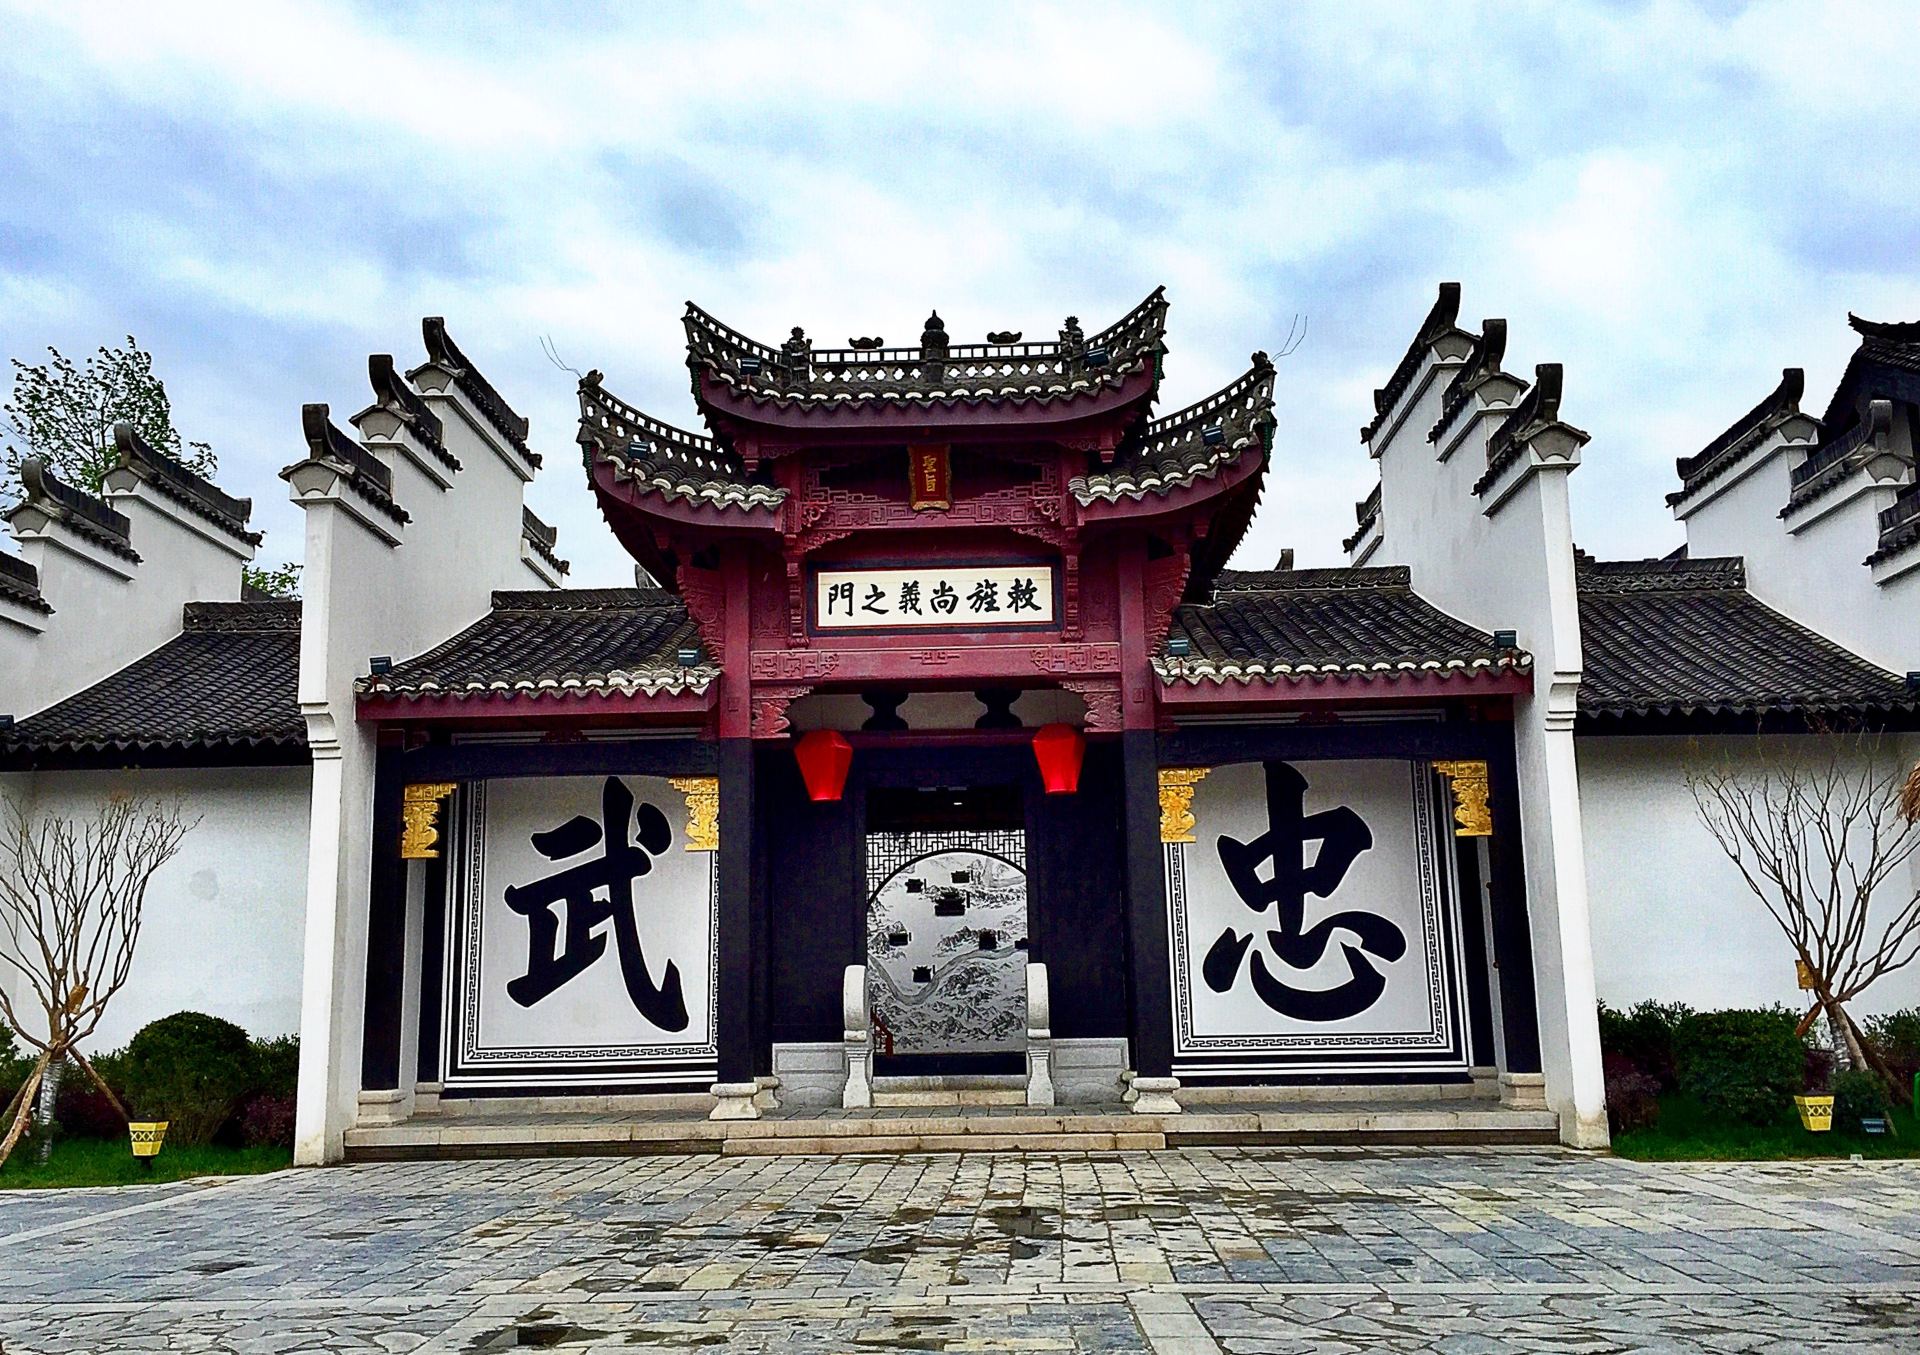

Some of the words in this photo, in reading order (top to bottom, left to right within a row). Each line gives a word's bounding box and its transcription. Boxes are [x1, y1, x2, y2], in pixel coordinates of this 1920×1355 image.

[922, 454, 937, 492] 聖旨
[504, 776, 690, 1033] 武
[1202, 760, 1407, 1022] 忠
